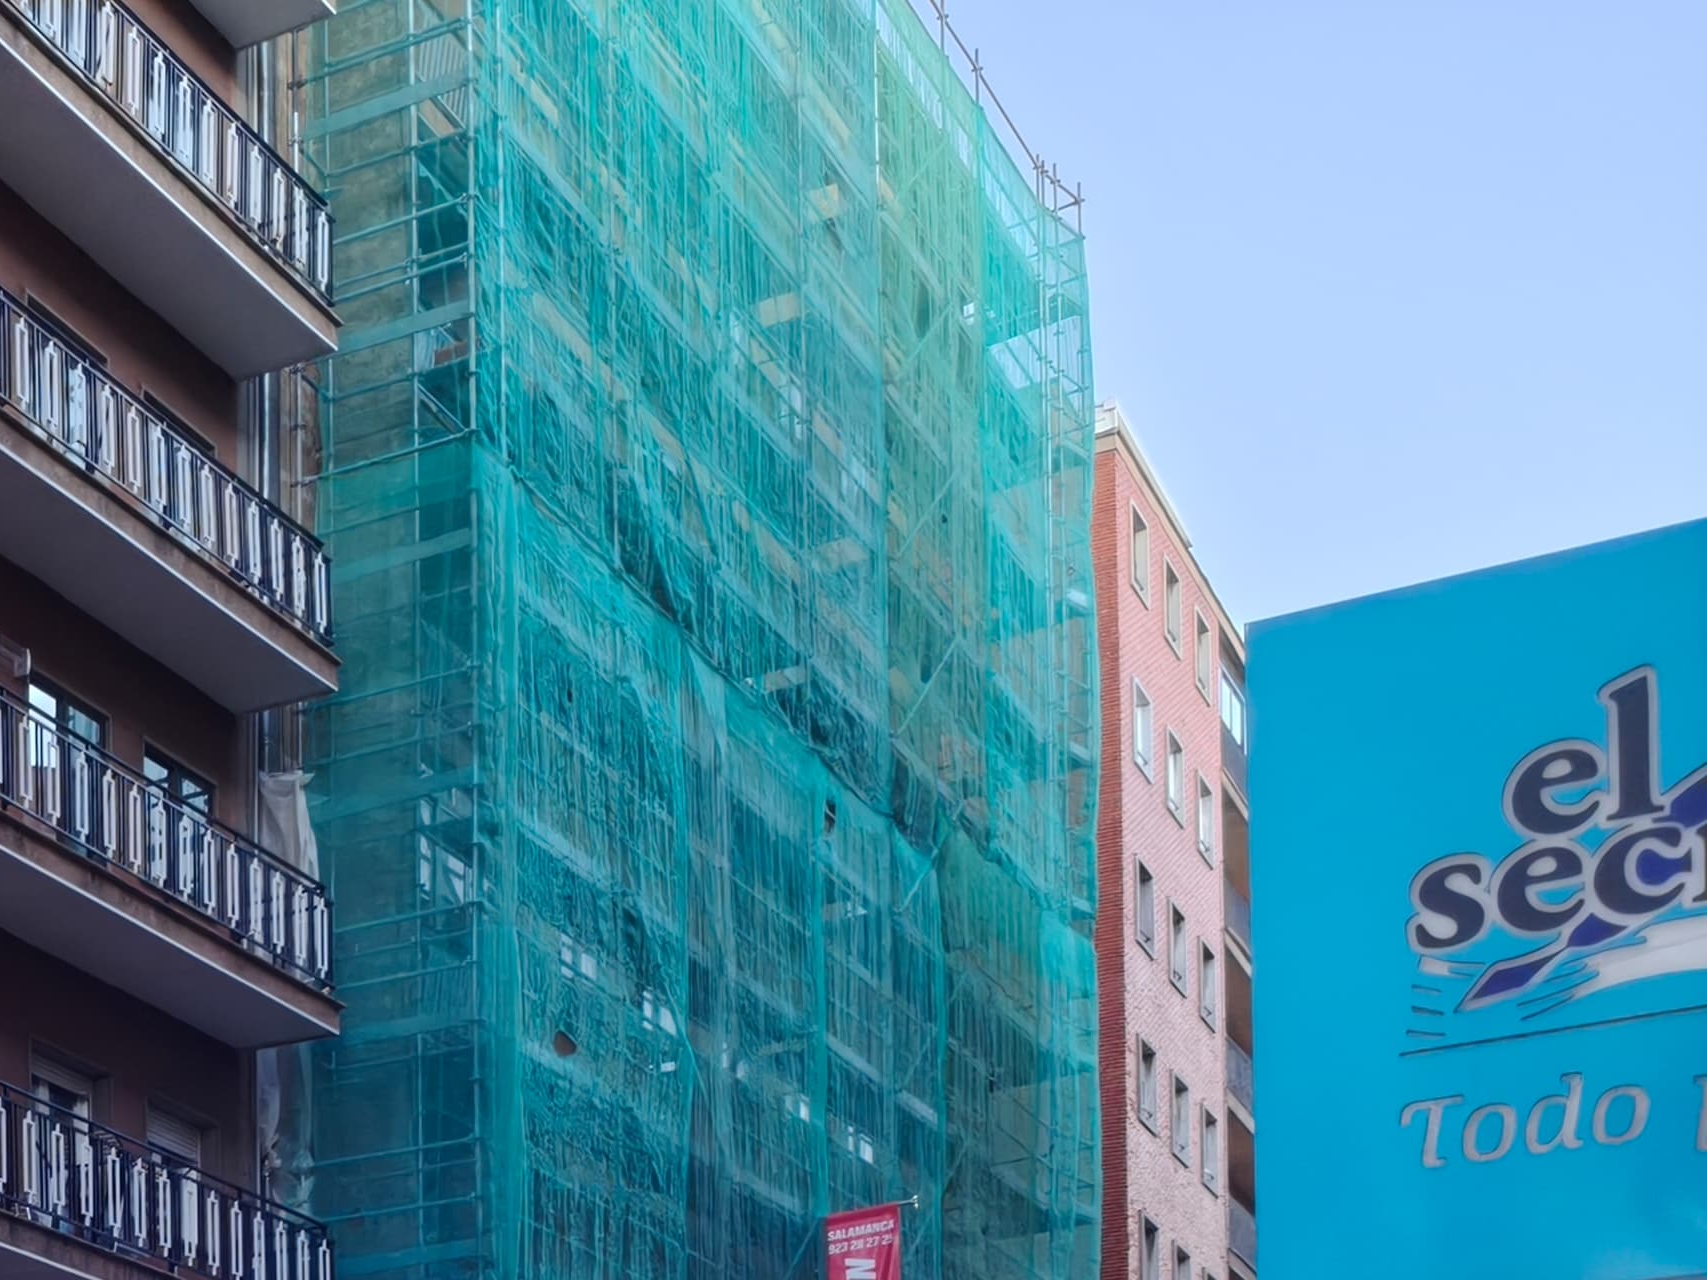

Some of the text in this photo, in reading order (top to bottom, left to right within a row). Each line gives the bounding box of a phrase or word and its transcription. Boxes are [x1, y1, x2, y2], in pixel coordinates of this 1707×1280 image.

[1501, 663, 1670, 840] el
[1399, 1071, 1651, 1169] Todo
[827, 1218, 895, 1242] SALAMANCA
